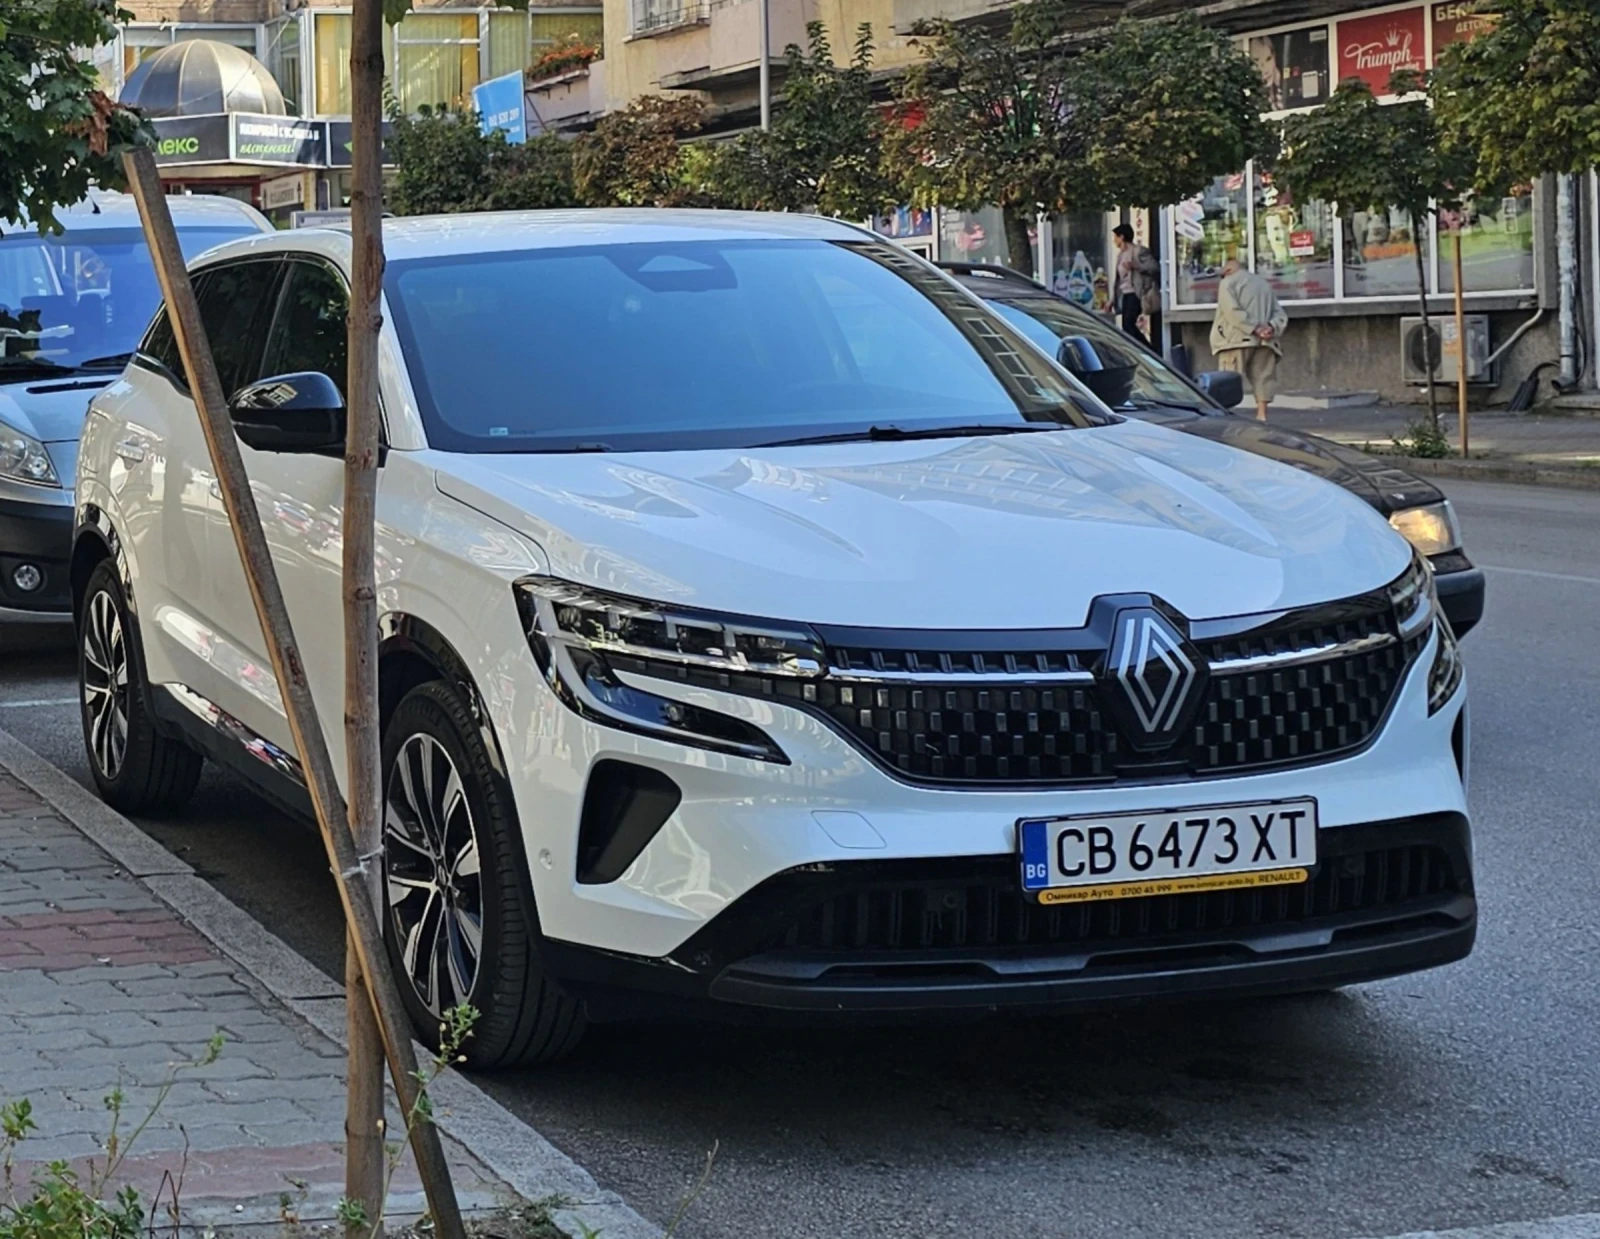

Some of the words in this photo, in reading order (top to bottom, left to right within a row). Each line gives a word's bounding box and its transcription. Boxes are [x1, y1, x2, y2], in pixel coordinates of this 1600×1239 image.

[1344, 29, 1413, 73] Triumph
[1056, 826, 1117, 877] CB
[1128, 817, 1239, 872] 6473
[1251, 810, 1306, 862] XT
[1026, 863, 1046, 879] BG
[1046, 890, 1089, 902] Омникар
[1091, 888, 1114, 899] Ауто
[1121, 886, 1141, 896] 0700
[1157, 883, 1172, 893] 999
[1258, 871, 1301, 883] RENAULT
